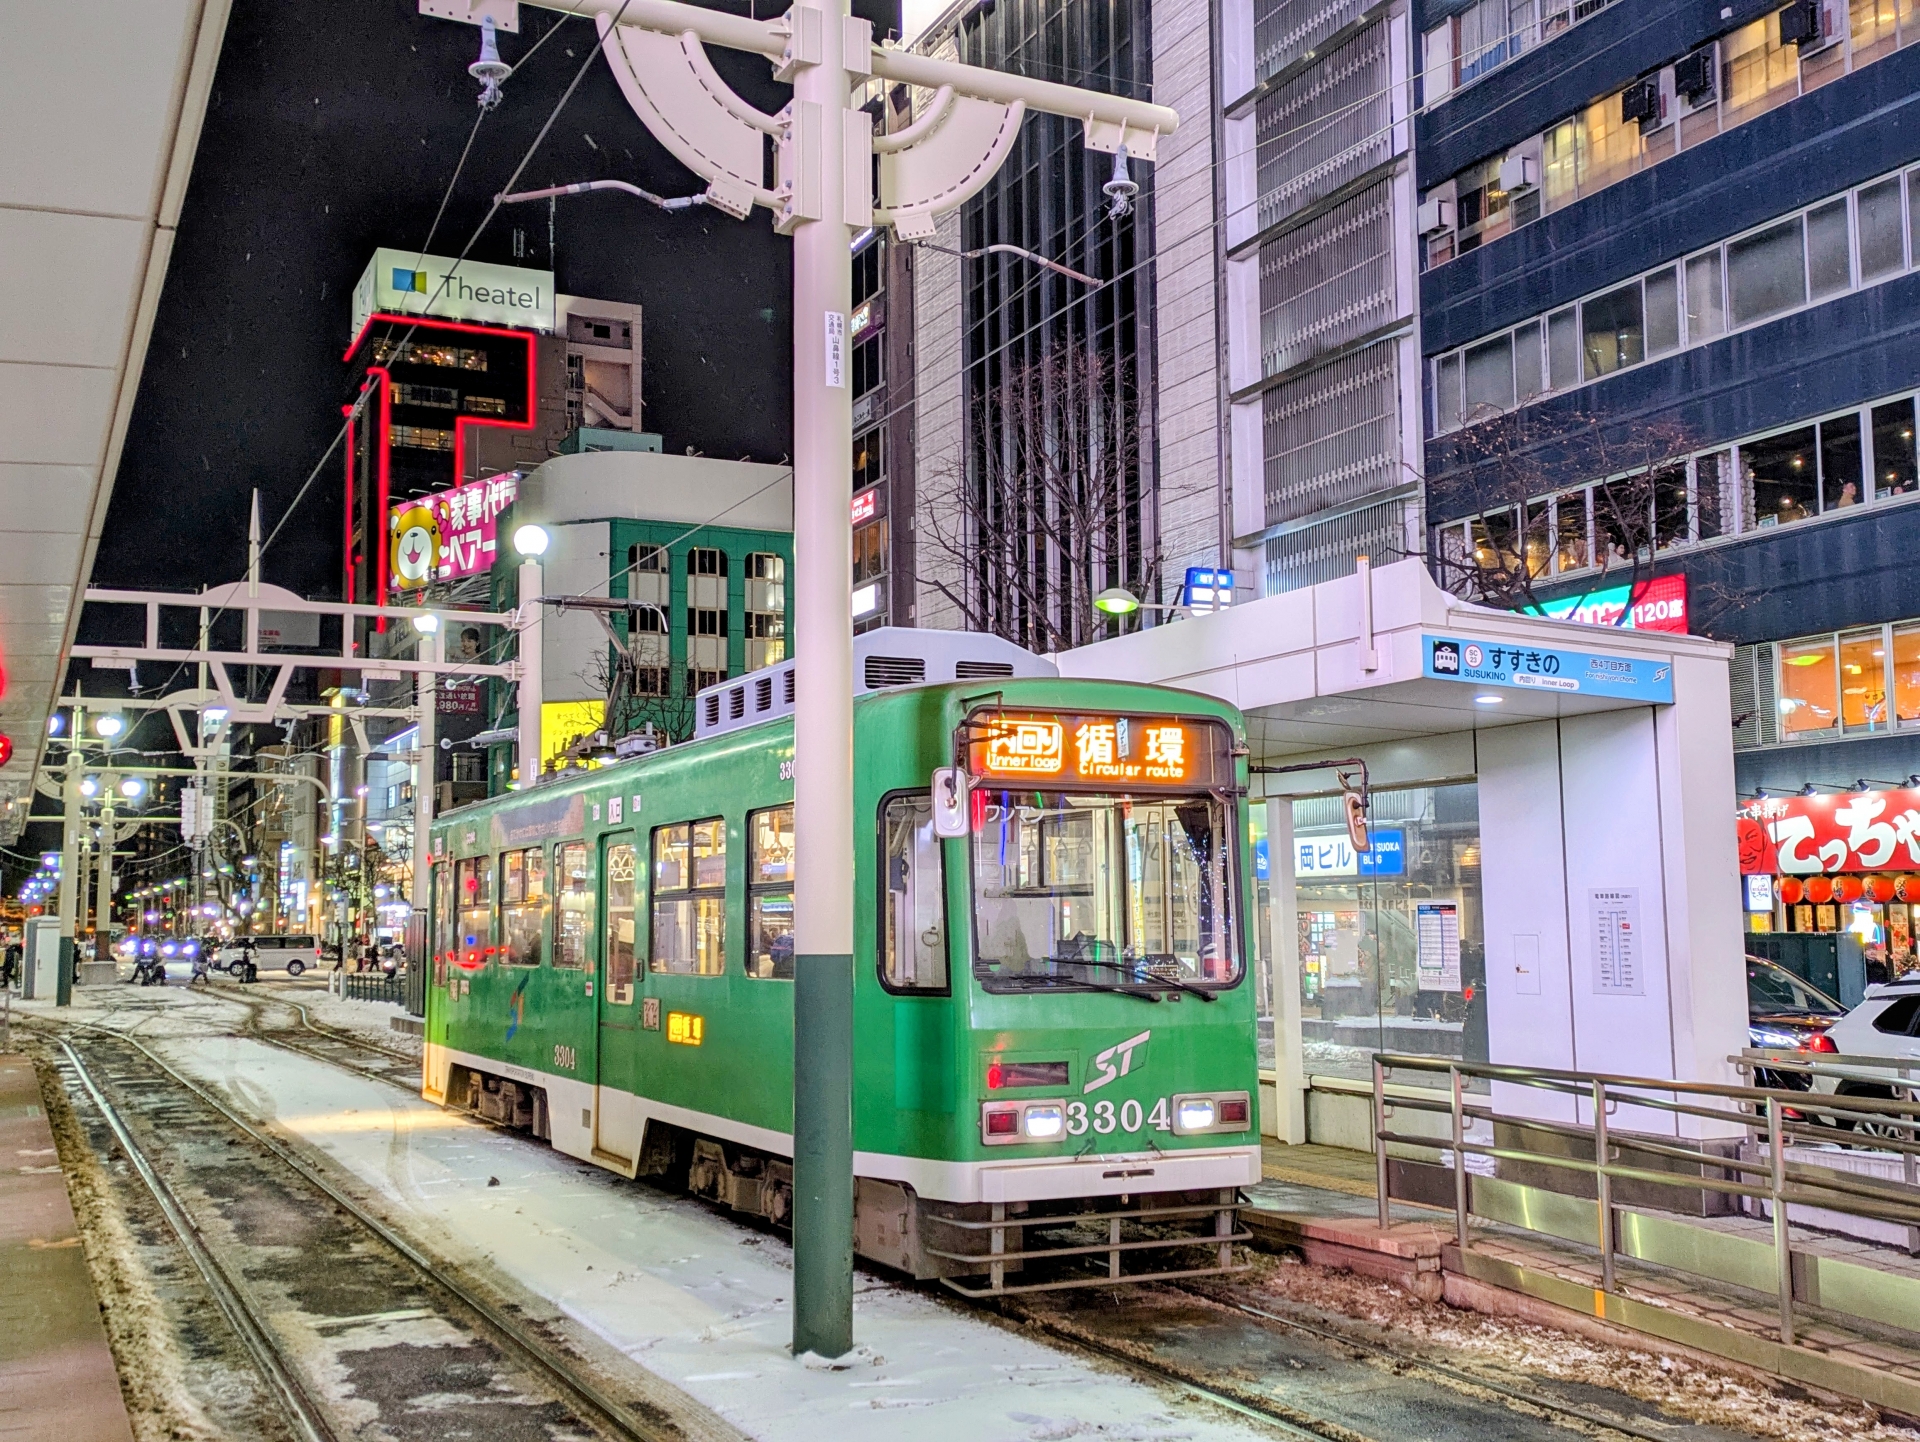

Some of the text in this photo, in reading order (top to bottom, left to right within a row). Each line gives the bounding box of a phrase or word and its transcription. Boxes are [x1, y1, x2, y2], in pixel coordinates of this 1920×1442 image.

[440, 274, 540, 310] Theatel
[450, 478, 517, 531] 家事代行
[449, 529, 496, 571] ベアー
[1469, 649, 1478, 657] SC
[1469, 656, 1477, 664] 23
[1489, 648, 1560, 675] すすきの
[1464, 669, 1506, 681] SUSUKINO
[1590, 659, 1632, 673] 西4丁目方面
[1519, 676, 1575, 689] 内回り Inner Loop
[1608, 674, 1619, 682] yon
[988, 724, 1059, 755] 内回り
[780, 760, 796, 780] 330
[990, 753, 1184, 778] Inner loop Circular route
[609, 803, 621, 819] 入口
[985, 804, 1045, 823] ワンマン
[1295, 842, 1352, 871] 岡ビル
[1363, 854, 1382, 864] BLG
[645, 1013, 657, 1026] 入口
[554, 1044, 576, 1070] 3304
[1083, 1029, 1151, 1095] ST
[1066, 1097, 1171, 1135] 3304
